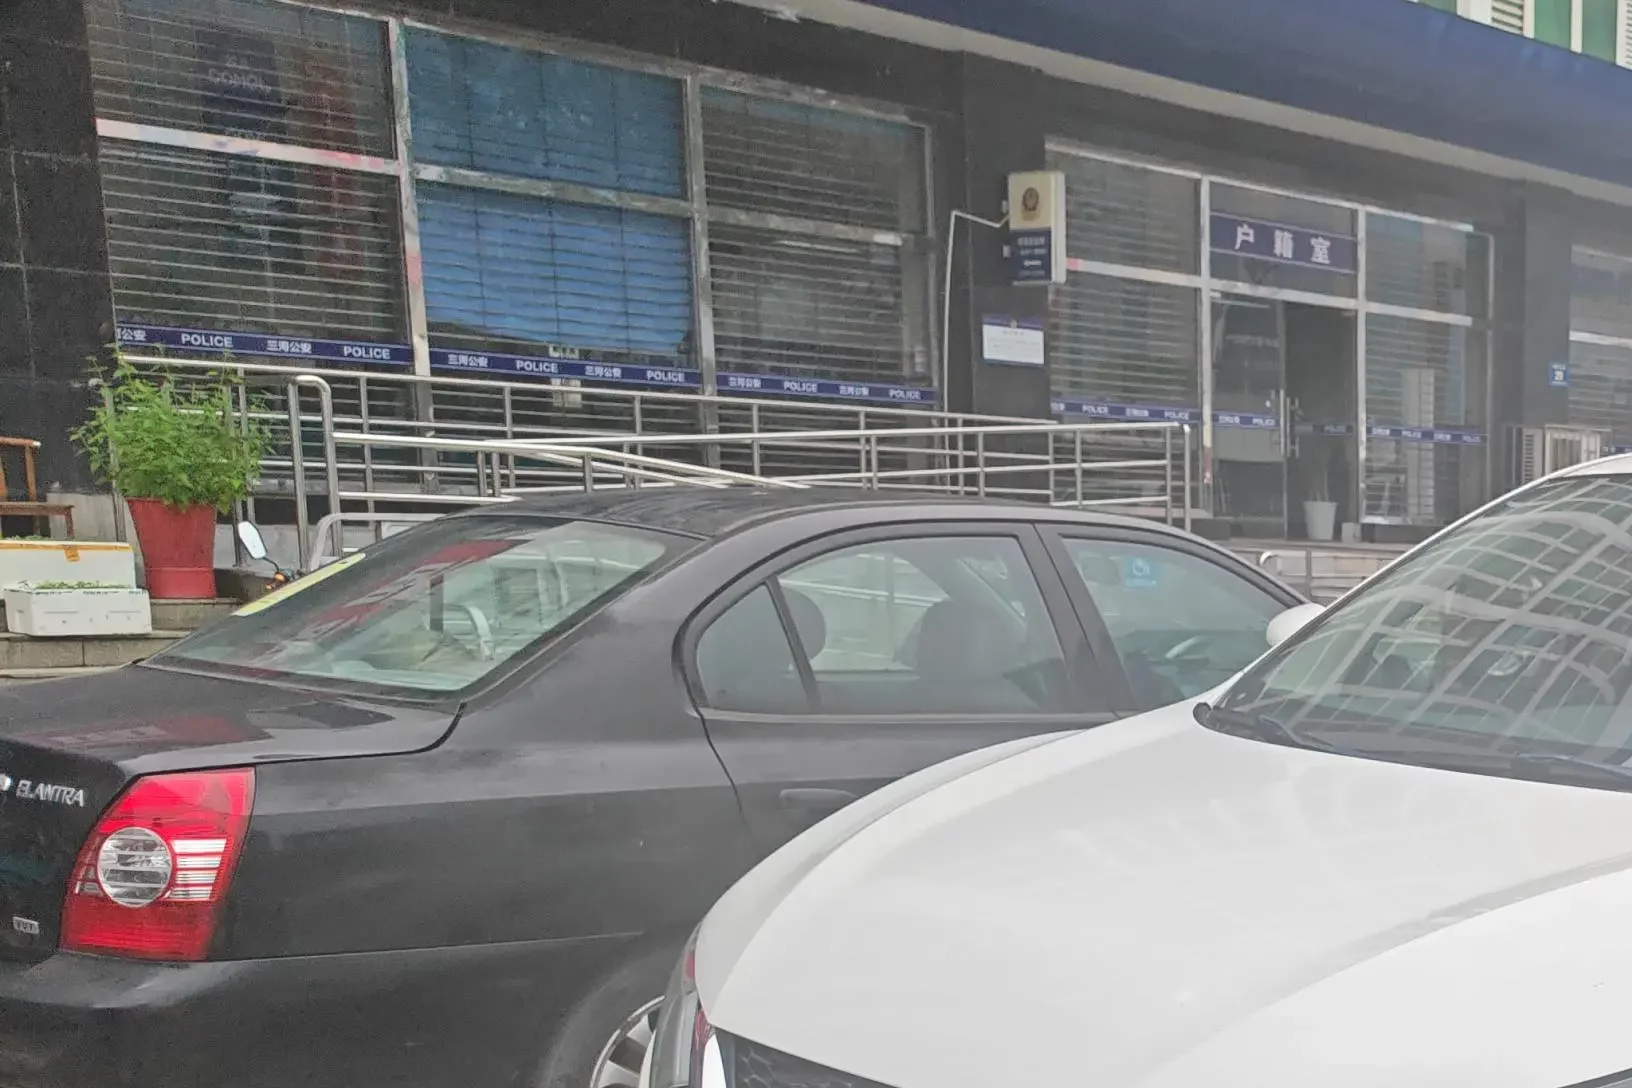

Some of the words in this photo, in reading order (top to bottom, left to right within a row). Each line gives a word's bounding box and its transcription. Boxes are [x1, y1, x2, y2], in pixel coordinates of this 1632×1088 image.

[1234, 222, 1331, 264] 户籍室
[181, 332, 233, 349] POLICE
[266, 339, 312, 355] 三河公安
[343, 345, 391, 360] POLICE
[447, 354, 488, 368] 三河公安
[516, 359, 558, 374] POLICE
[585, 365, 622, 378] 三河公安
[646, 369, 685, 383] POLICE
[783, 380, 818, 393] POLICE
[888, 389, 921, 400] POLICE
[16, 779, 84, 807] ELANTRA
